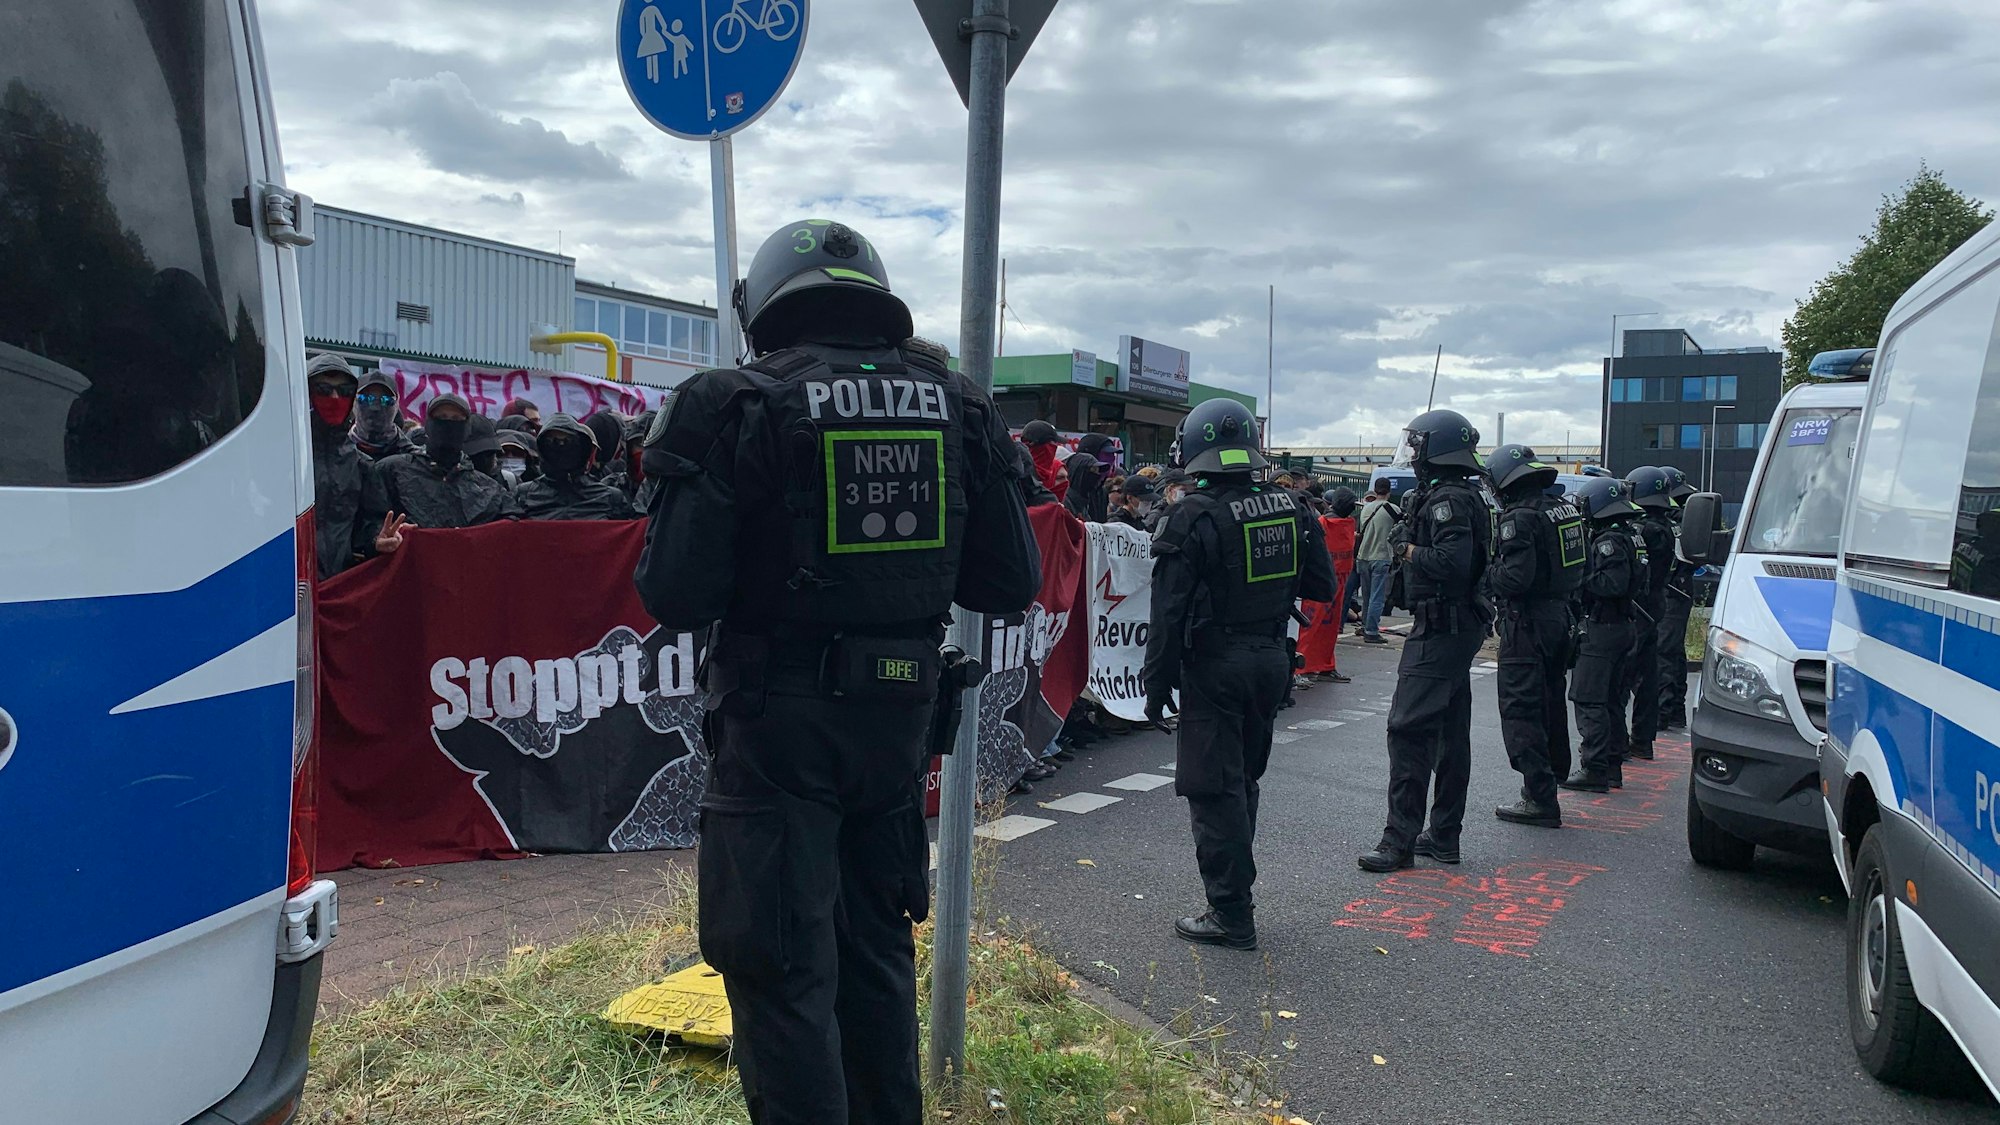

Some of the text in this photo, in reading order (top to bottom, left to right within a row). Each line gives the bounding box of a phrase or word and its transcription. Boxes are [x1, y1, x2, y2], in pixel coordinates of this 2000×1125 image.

[792, 228, 817, 254] 3
[806, 379, 949, 422] POLIZEI
[1202, 419, 1250, 442] 3 1
[1460, 426, 1470, 442] 3
[1790, 428, 1828, 438] 3 BF 13
[1794, 419, 1830, 430] NRW
[854, 444, 920, 474] NRW
[1510, 448, 1521, 460] 3
[846, 480, 930, 505] 3 BF 11
[1608, 486, 1618, 498] 3
[1655, 479, 1663, 491] 3
[1229, 493, 1296, 521] POLIZEI
[1257, 525, 1287, 544] NRW
[1254, 543, 1291, 559] 3 BF 11
[991, 618, 1027, 674] in
[885, 660, 912, 679] BFE
[430, 644, 647, 731] Stoppt
